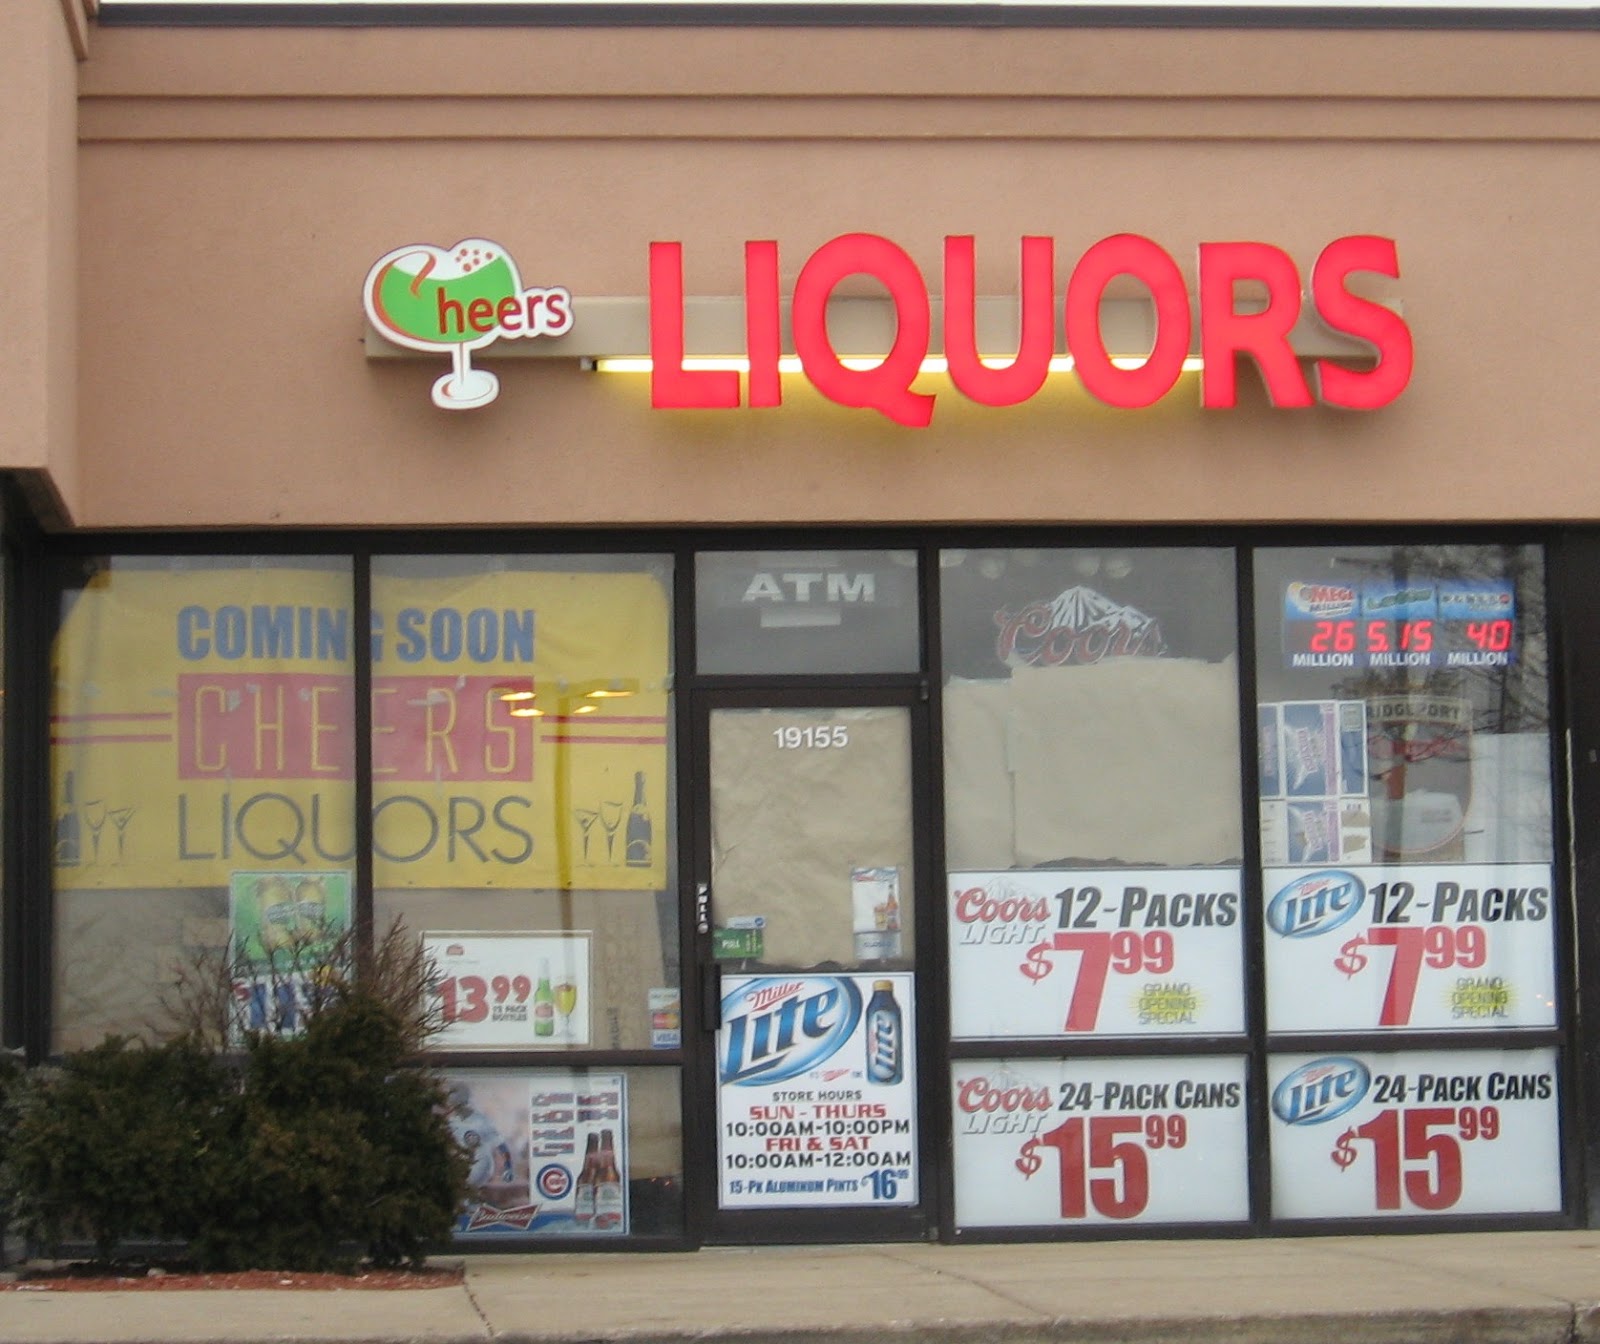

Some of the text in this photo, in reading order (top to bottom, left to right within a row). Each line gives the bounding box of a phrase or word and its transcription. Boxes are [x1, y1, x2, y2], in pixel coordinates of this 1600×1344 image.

[649, 232, 1413, 428] LIQUORS
[742, 573, 876, 602] ATM
[396, 608, 535, 662] SOON
[1310, 621, 1356, 652] 26
[1467, 620, 1512, 652] 40
[1293, 653, 1354, 667] MILLION
[1370, 653, 1431, 666] MILLION
[1447, 652, 1508, 665] MILLION
[194, 684, 517, 775] CHEERS
[773, 726, 849, 749] 19155
[178, 792, 535, 865] LIQUORS
[954, 886, 1051, 924] Coors
[1055, 885, 1238, 929] 12-PACKS
[1368, 881, 1549, 924] 12-PACKS
[959, 923, 1047, 946] LIGHT
[746, 982, 805, 1011] Miller
[720, 988, 839, 1085] Lite
[772, 1090, 863, 1102] STORE HOURS
[957, 1076, 1053, 1113] Coors
[1058, 1079, 1241, 1112] 24-PACK CANS
[1373, 1071, 1552, 1104] 24-PACK CANS
[750, 1106, 795, 1120] SUN
[813, 1104, 887, 1119] THURS
[962, 1113, 1048, 1135] LIGHT
[726, 1119, 910, 1137] 10:00AM-10:00PM
[765, 1136, 872, 1152] FRI & SAT
[726, 1151, 912, 1169] 10:00AM-12:00AM
[765, 1180, 824, 1194] ALUMINUM
[826, 1178, 859, 1193] PINTS
